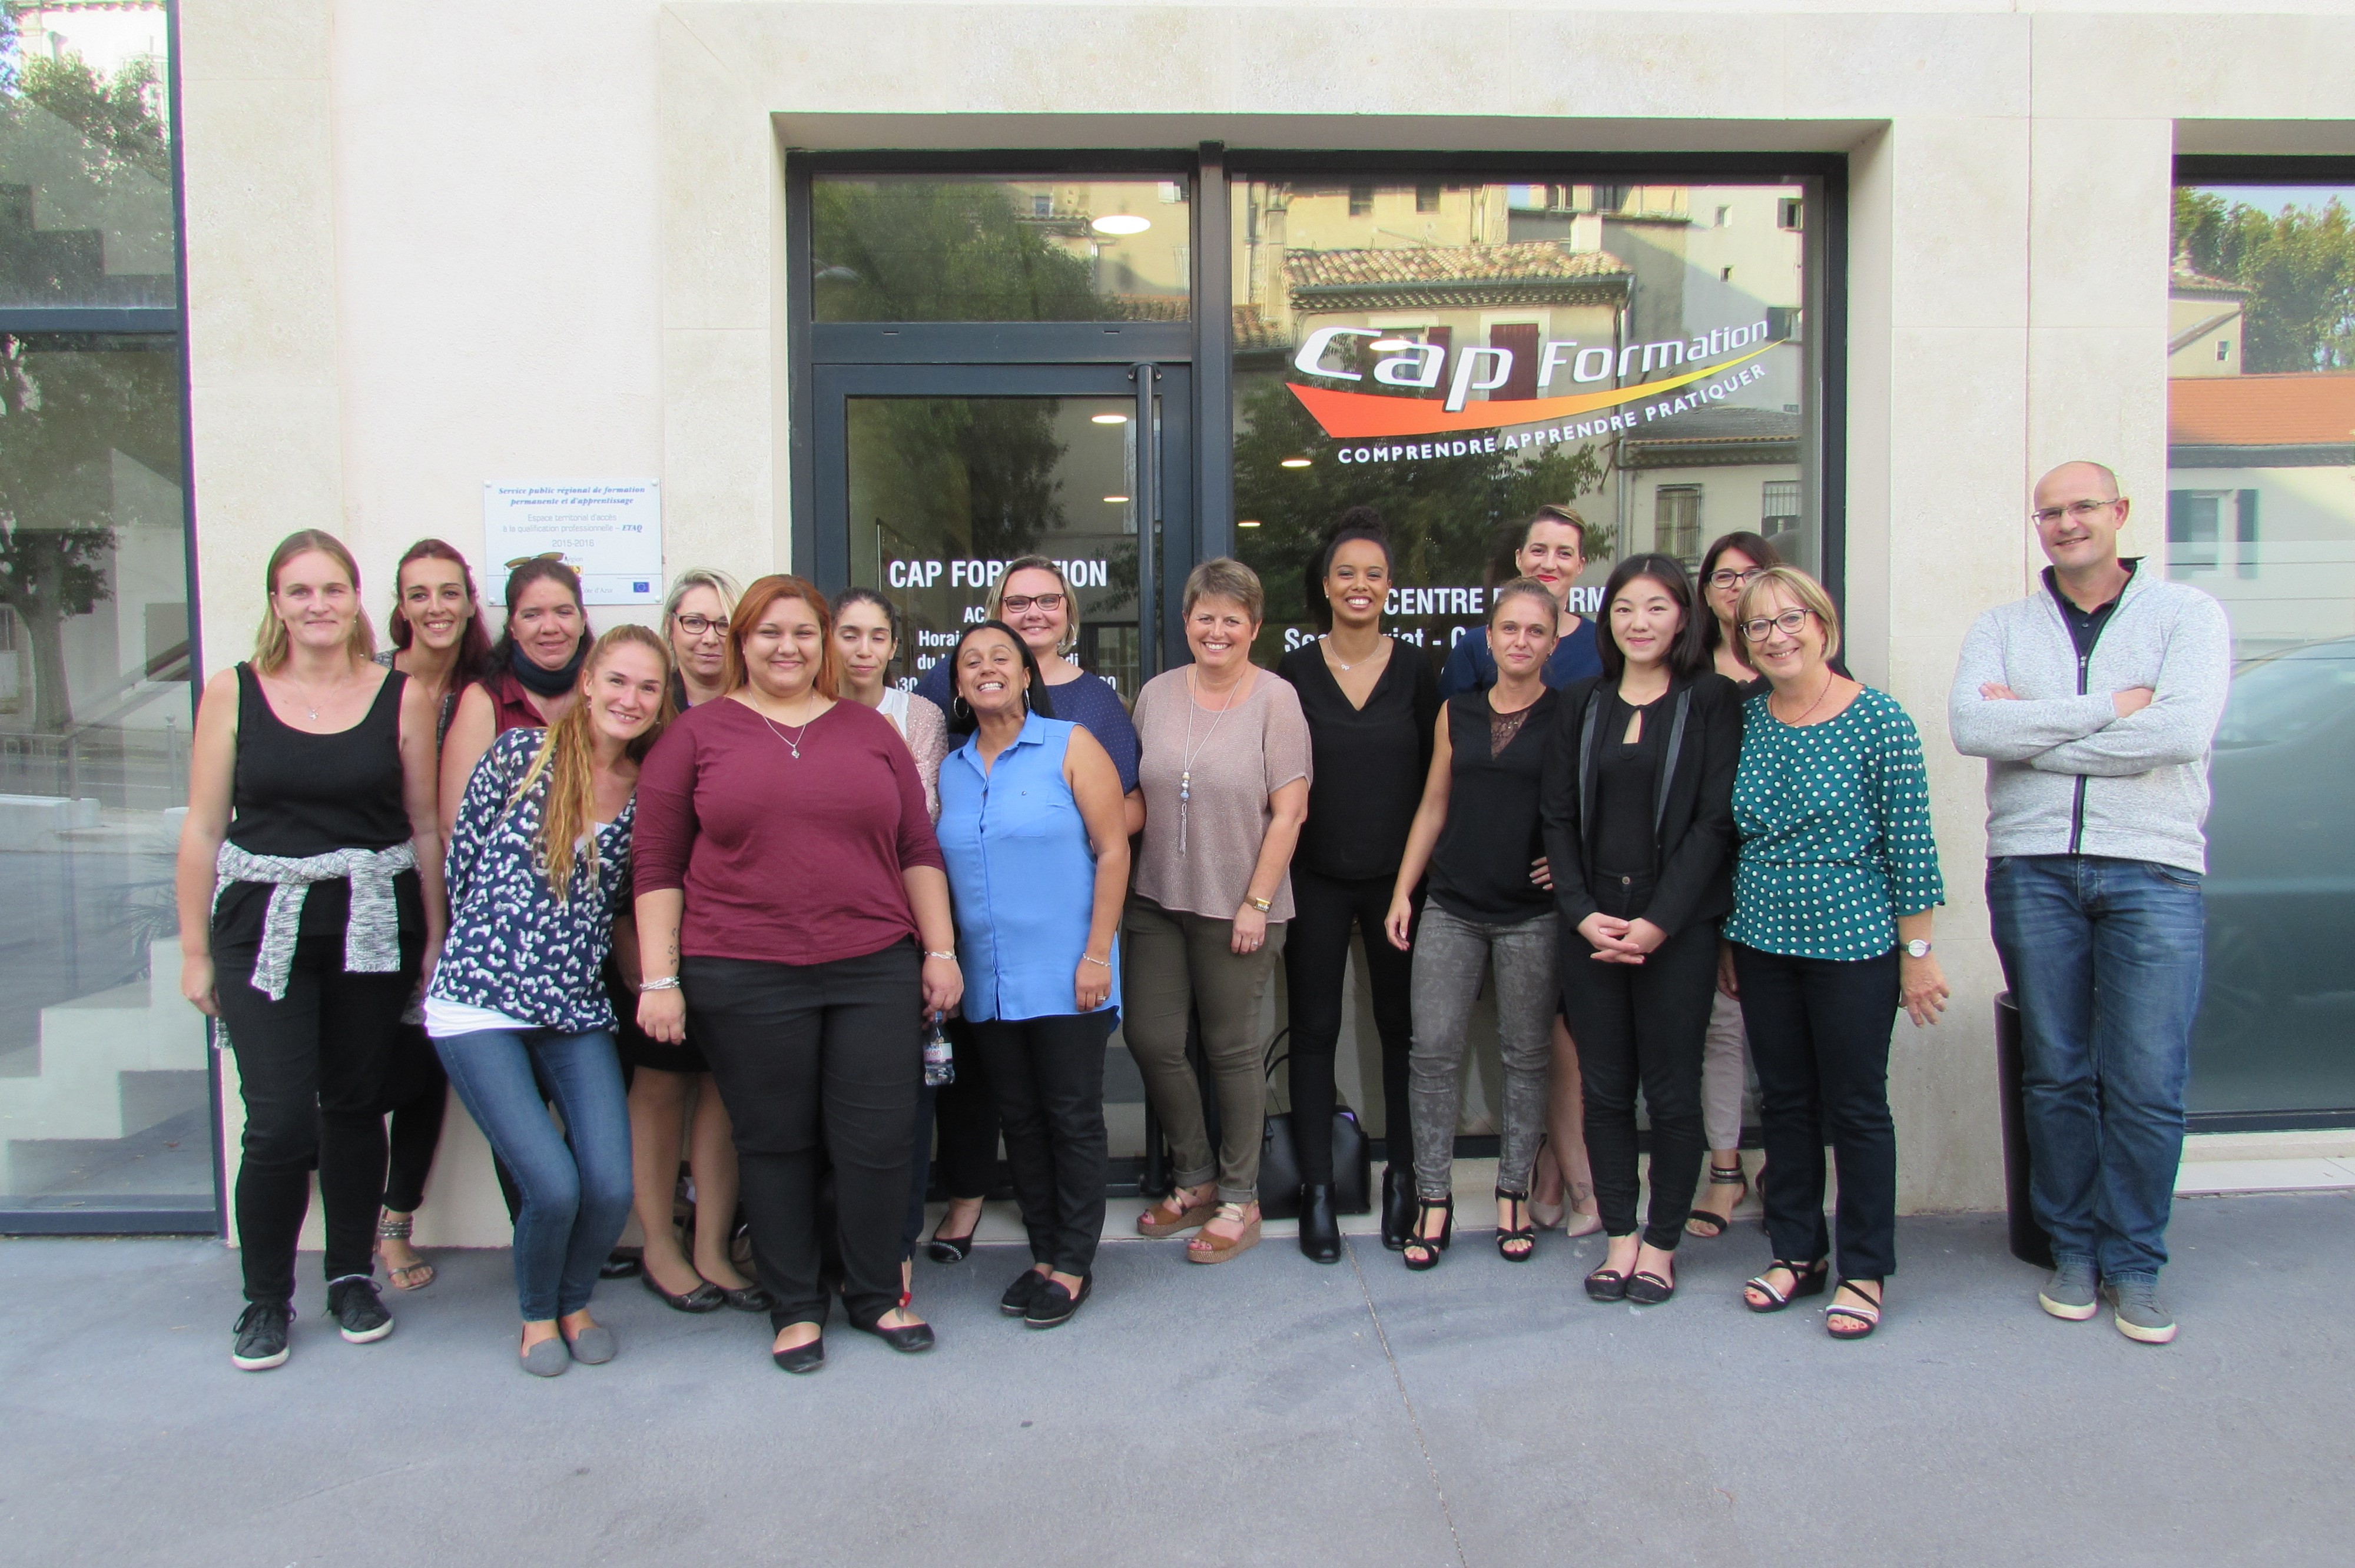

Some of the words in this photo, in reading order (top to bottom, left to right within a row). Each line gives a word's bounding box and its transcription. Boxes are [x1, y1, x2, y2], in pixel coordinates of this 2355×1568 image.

[1295, 327, 1512, 411] Cap
[1538, 320, 1768, 387] Formation
[1338, 437, 1497, 464] COMPRENDRE
[1504, 413, 1637, 459] APPRENDRE
[1645, 363, 1766, 422] PRATIQUER
[528, 487, 555, 496] public
[557, 487, 591, 495] régional
[602, 486, 645, 495] formation
[510, 498, 559, 507] permanente
[570, 497, 633, 506] d'apprentissage
[528, 514, 553, 522] Espace
[555, 513, 588, 521] territorial
[518, 525, 559, 533] qualification
[622, 524, 643, 533] ETAQ
[890, 560, 942, 587] CAP
[951, 560, 1107, 587] FORION
[1384, 587, 1483, 614] CENTRE
[919, 630, 962, 646] Horai
[917, 654, 936, 670] du
